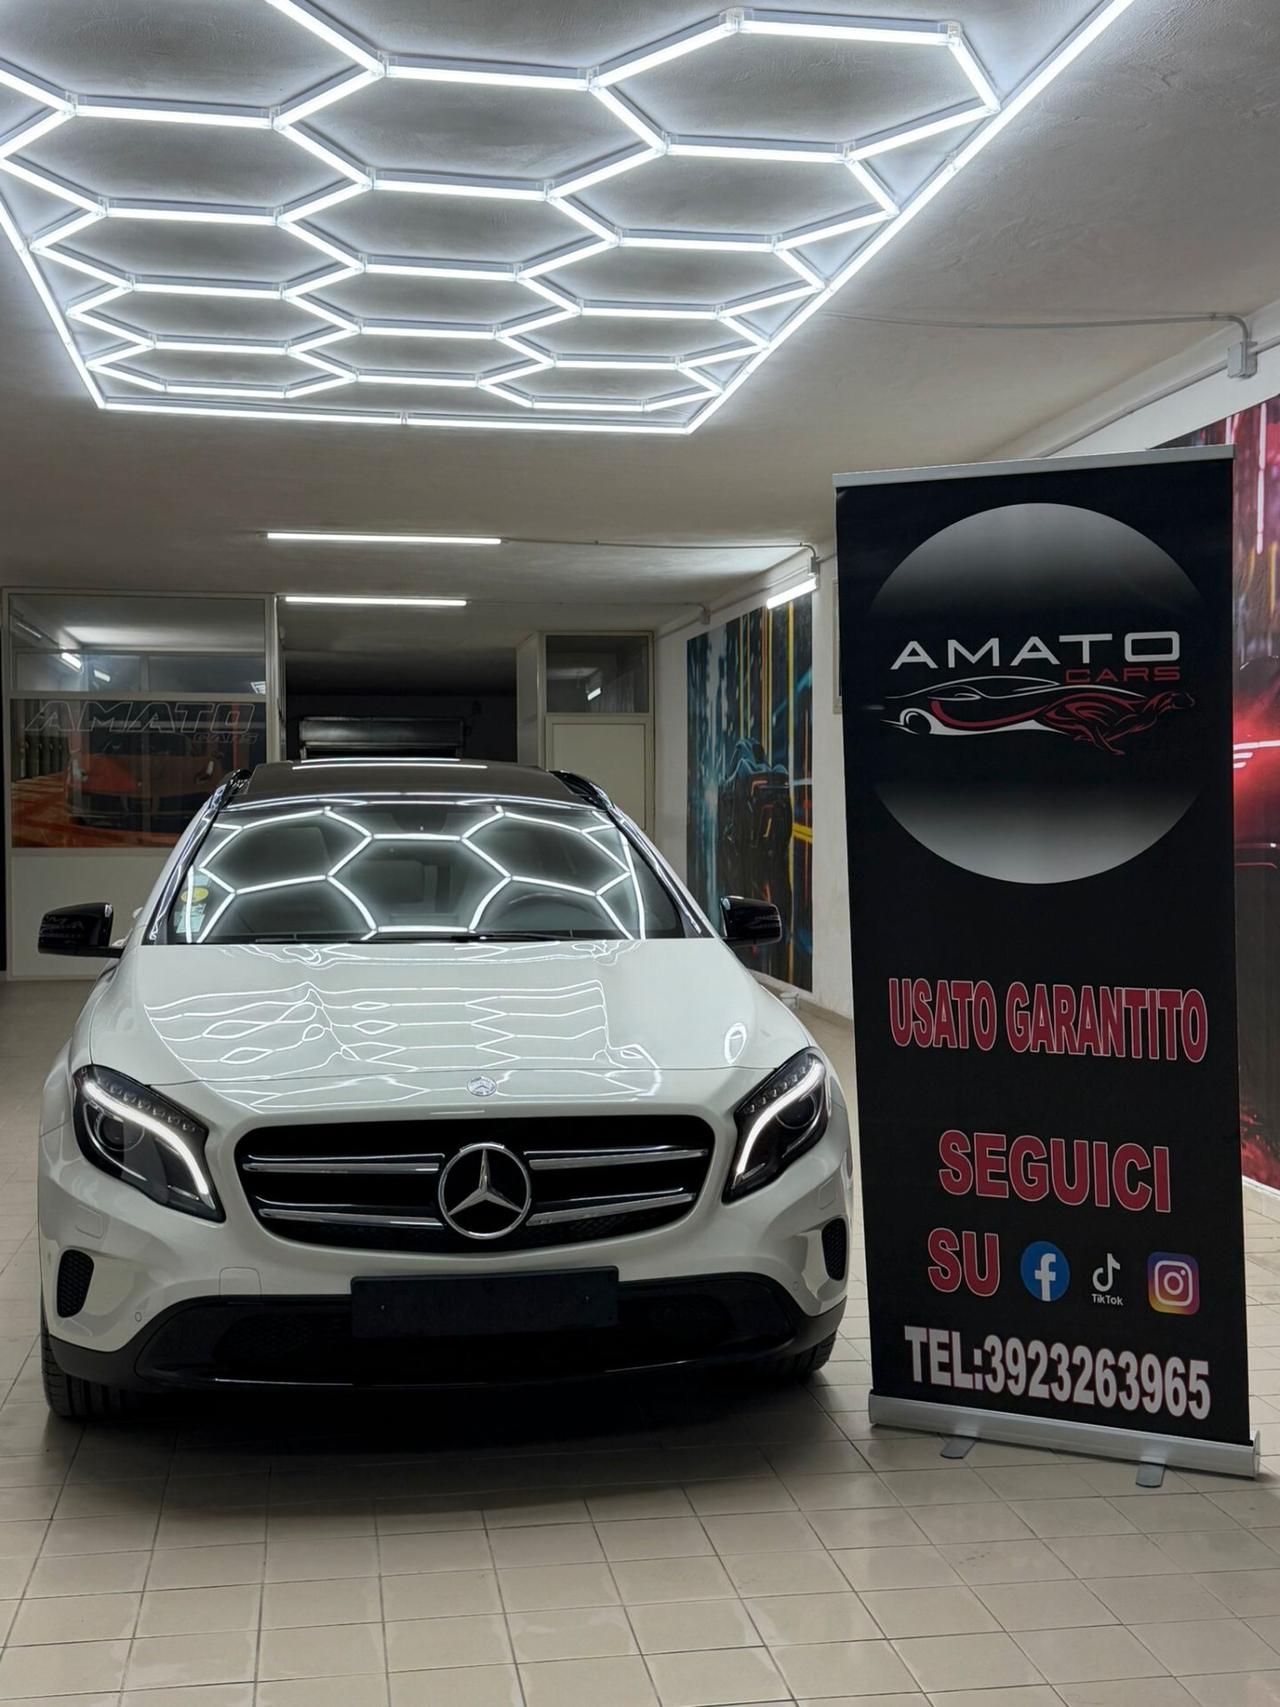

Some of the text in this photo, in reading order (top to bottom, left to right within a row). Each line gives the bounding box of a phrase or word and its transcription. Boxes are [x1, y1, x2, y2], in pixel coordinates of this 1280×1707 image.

[890, 631, 1180, 669] AMATO
[1065, 666, 1180, 683] CARS
[25, 701, 255, 733] AMATO
[889, 978, 1208, 1063] USATO GARANTITO
[938, 1129, 1171, 1213] SEGUICI
[927, 1227, 1000, 1297] SU
[1091, 1293, 1124, 1306] TikTok
[904, 1325, 1211, 1420] TEL:3923263965
